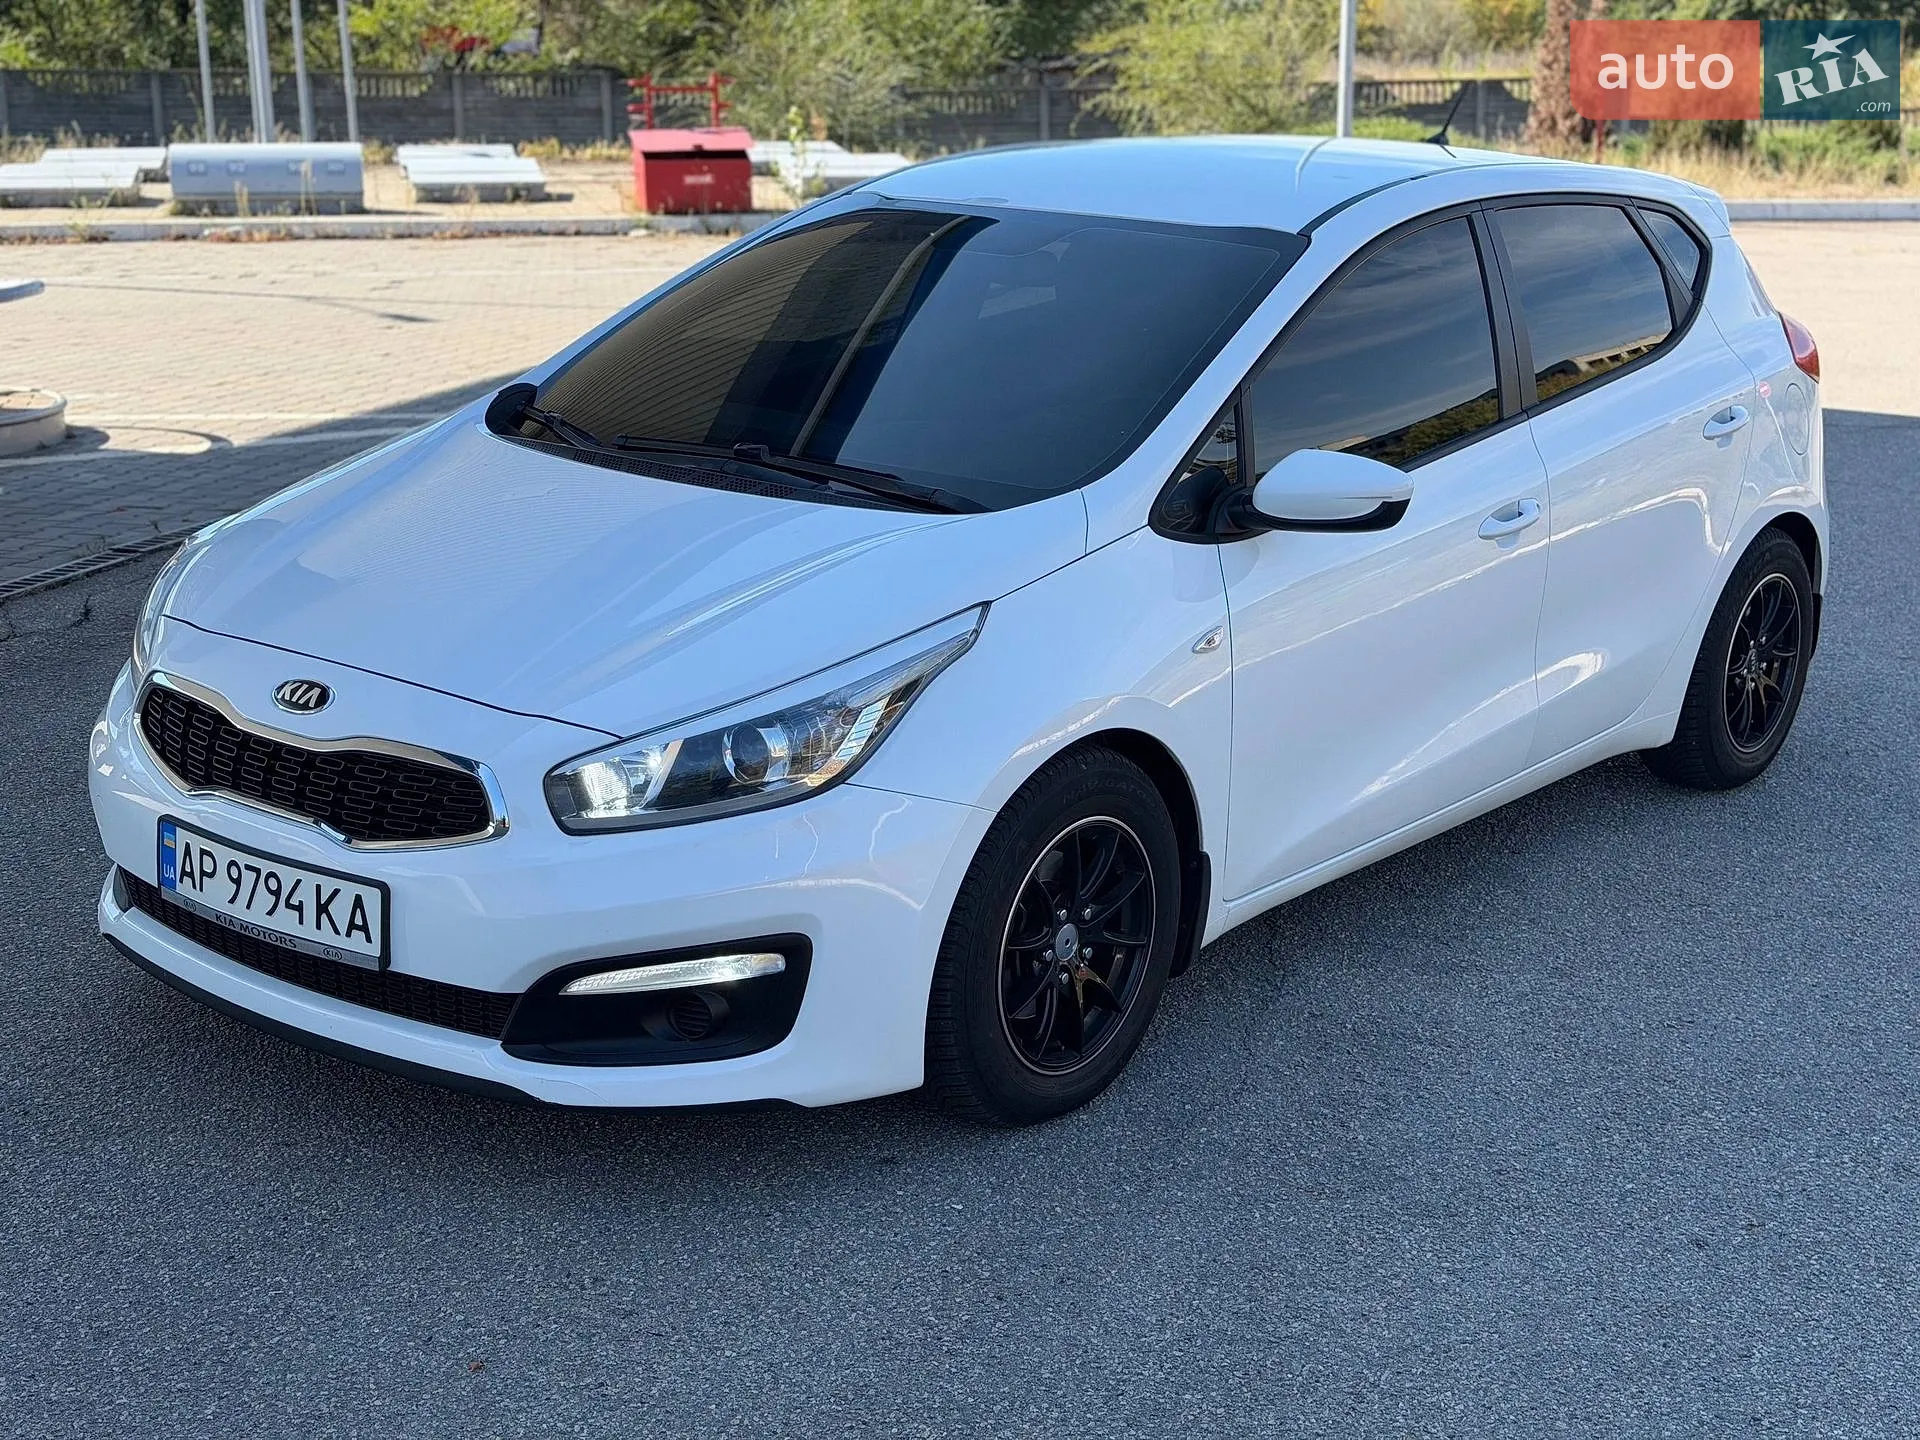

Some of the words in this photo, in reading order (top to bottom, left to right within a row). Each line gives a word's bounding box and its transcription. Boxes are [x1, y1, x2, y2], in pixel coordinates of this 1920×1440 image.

[277, 682, 322, 708] KIA
[163, 864, 176, 881] UA
[179, 841, 218, 892] AP
[226, 860, 304, 926] 9794
[315, 884, 373, 944] KA
[215, 913, 236, 929] KIA
[240, 923, 297, 949] MOTORS
